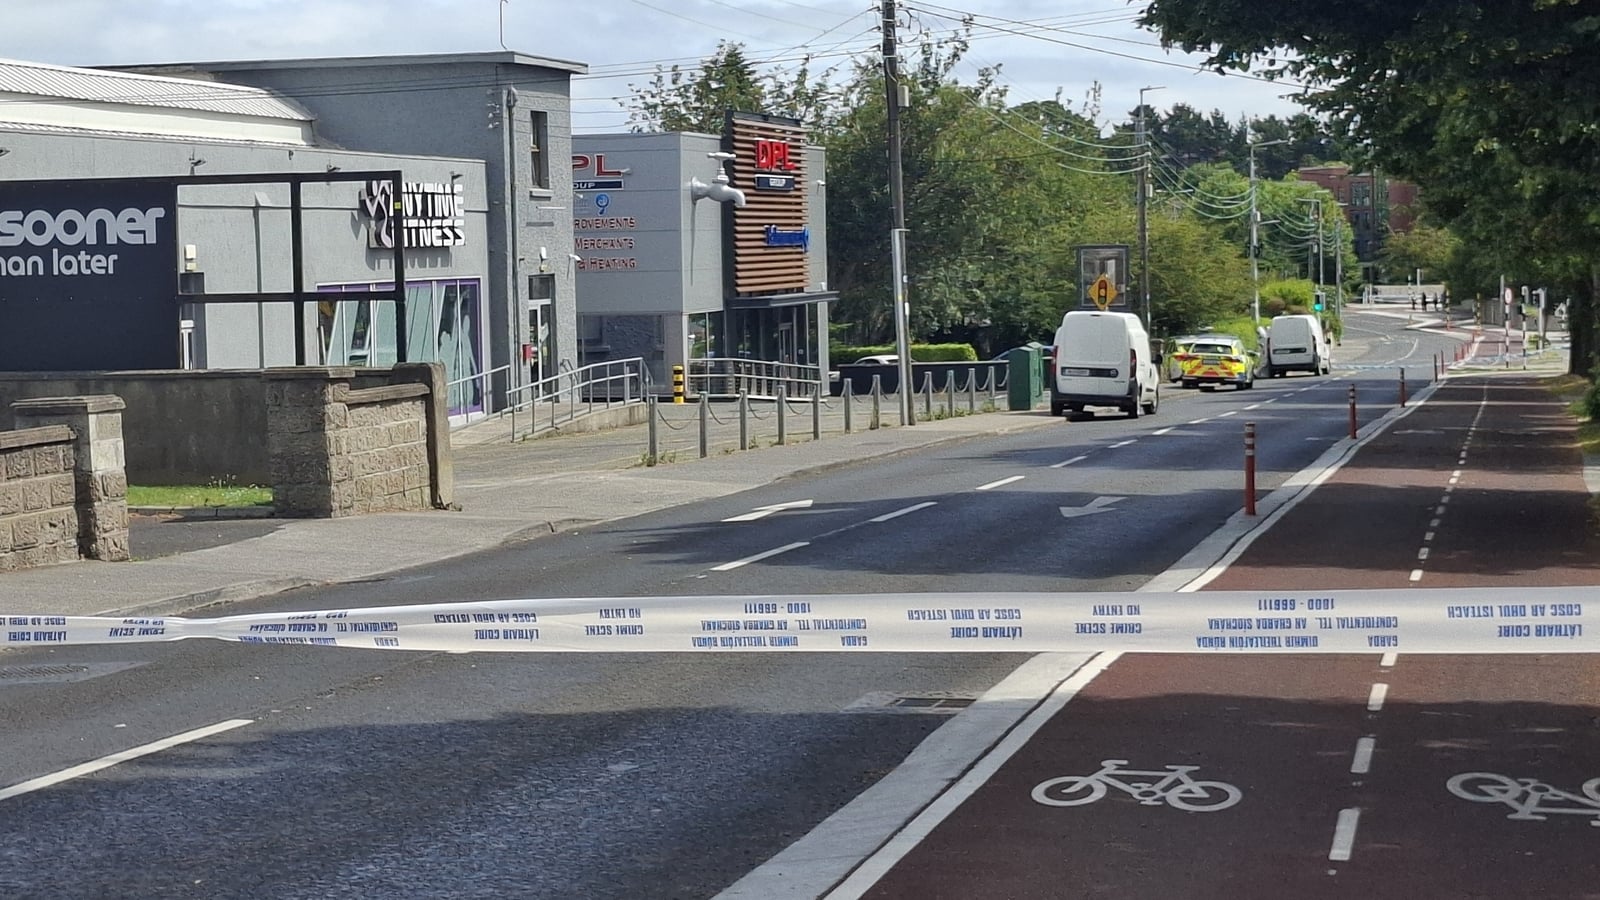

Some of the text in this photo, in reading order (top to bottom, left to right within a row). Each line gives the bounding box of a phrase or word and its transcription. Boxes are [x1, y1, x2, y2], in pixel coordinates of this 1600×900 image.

[755, 139, 797, 170] DPL
[0, 207, 165, 246] sooner
[392, 219, 465, 247] ITNESS
[575, 237, 635, 250] MERCHANTS
[53, 248, 118, 275] later
[589, 257, 637, 270] HEATING
[1092, 605, 1140, 616] NO ENTRY
[1258, 599, 1295, 611] 666111
[1308, 598, 1334, 610] 1800
[1447, 604, 1581, 618] COSC AR DHUL ISTEACH
[1075, 623, 1142, 634] CRIME SCENE
[1256, 618, 1291, 630] GHARDA
[1295, 618, 1307, 629] AN
[1315, 616, 1398, 629] CONFIDENTIAL TEL.
[1497, 624, 1582, 639] LÁTHAIR COIRE
[1196, 637, 1226, 651] RÚNDA
[1368, 635, 1398, 647] GARDA
